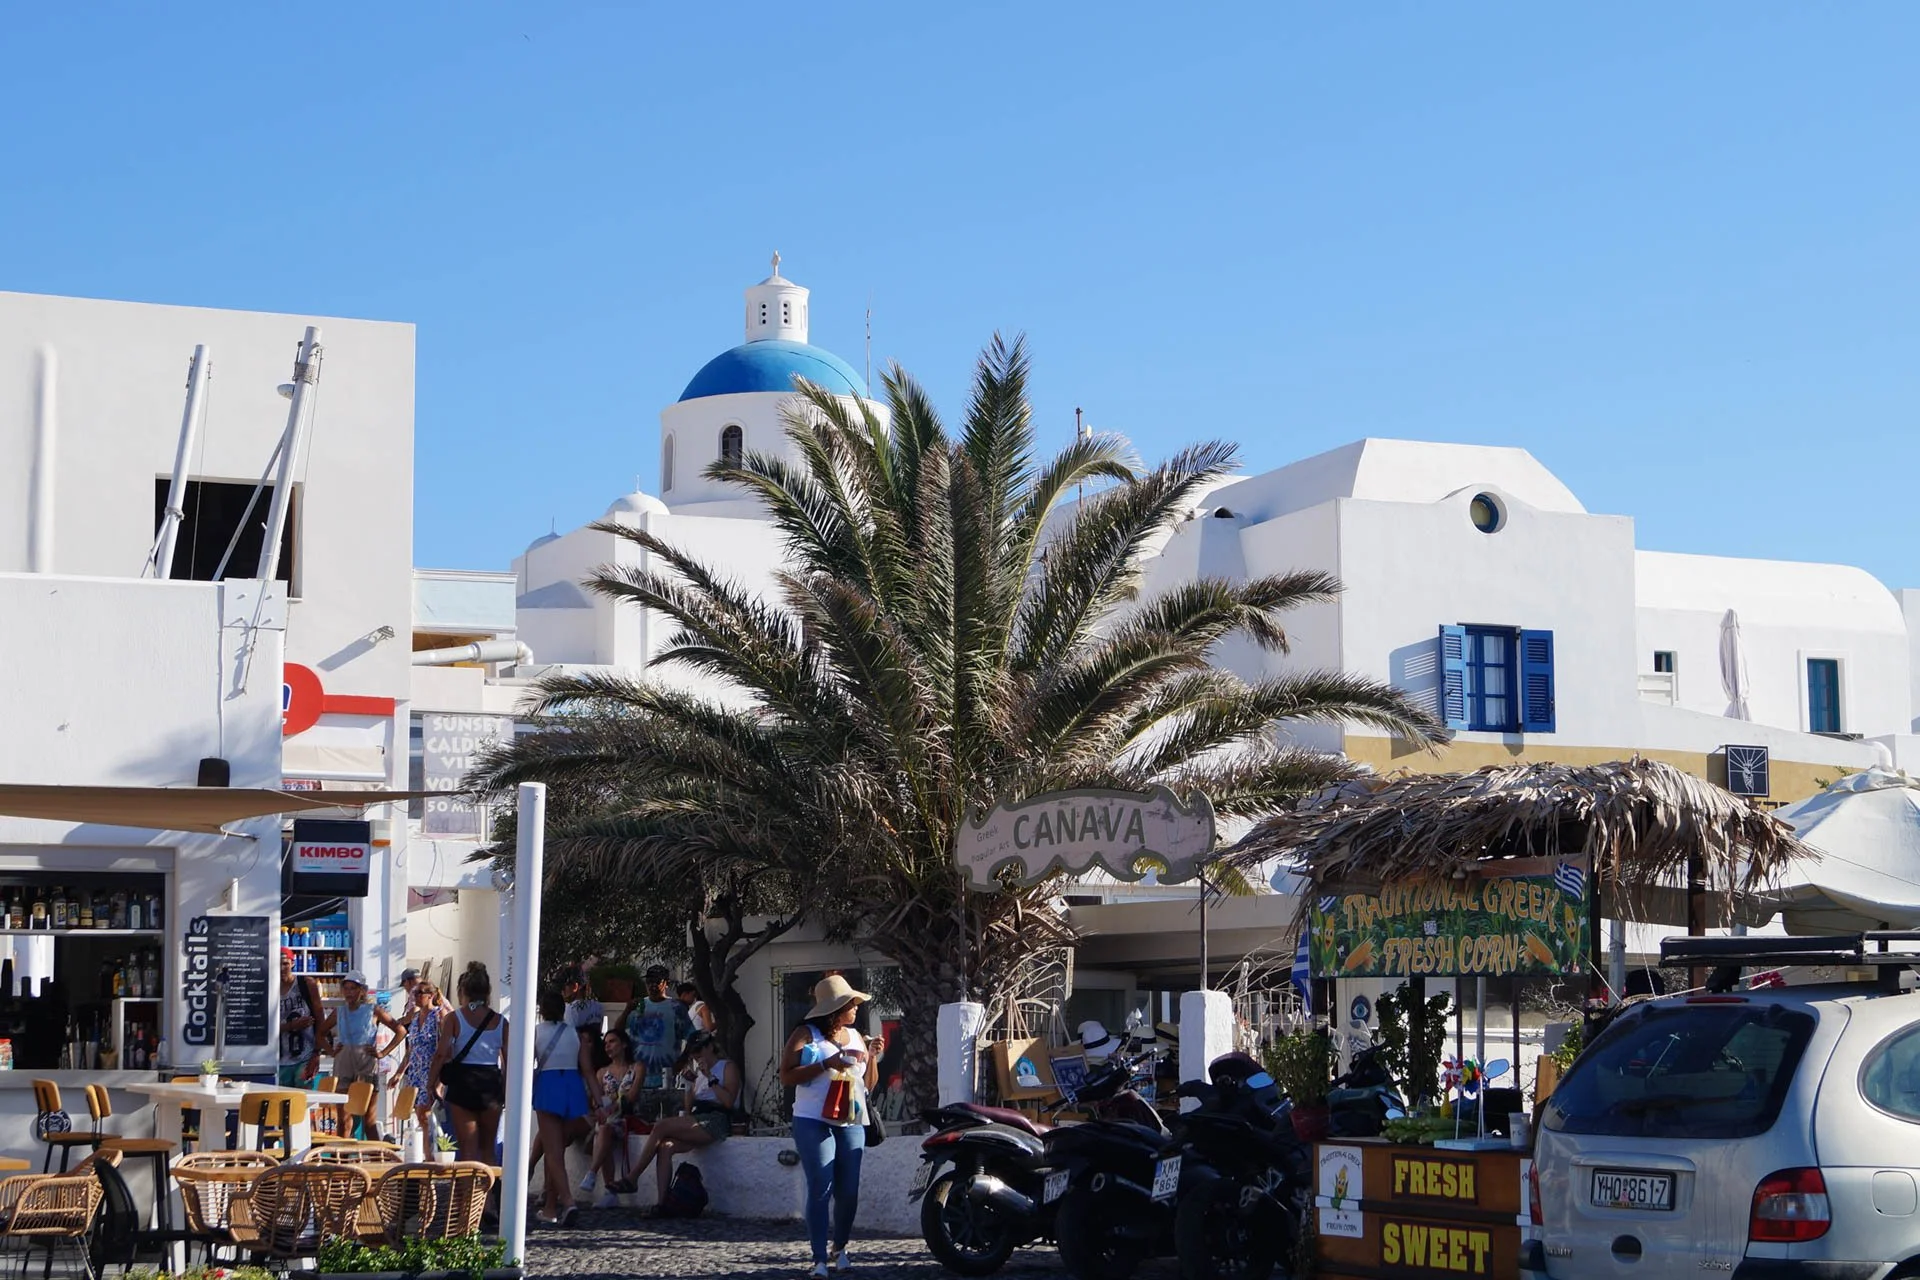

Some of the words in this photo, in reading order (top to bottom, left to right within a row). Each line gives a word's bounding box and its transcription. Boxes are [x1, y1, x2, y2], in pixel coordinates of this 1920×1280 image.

[432, 715, 503, 732] SUNSET
[427, 801, 448, 813] 50
[976, 825, 1000, 842] Greek
[1013, 805, 1146, 850] CANAVA
[299, 845, 364, 859] KIMBO
[1343, 877, 1480, 931] TRADITIONAL
[1483, 877, 1560, 933] GREEK
[1383, 937, 1454, 977] FRESH
[1458, 935, 1520, 975] CORN
[187, 919, 208, 1042] Cocktails
[1158, 1176, 1178, 1192] 863
[1394, 1159, 1476, 1199] FRESH
[1382, 1222, 1490, 1274] SWEET
